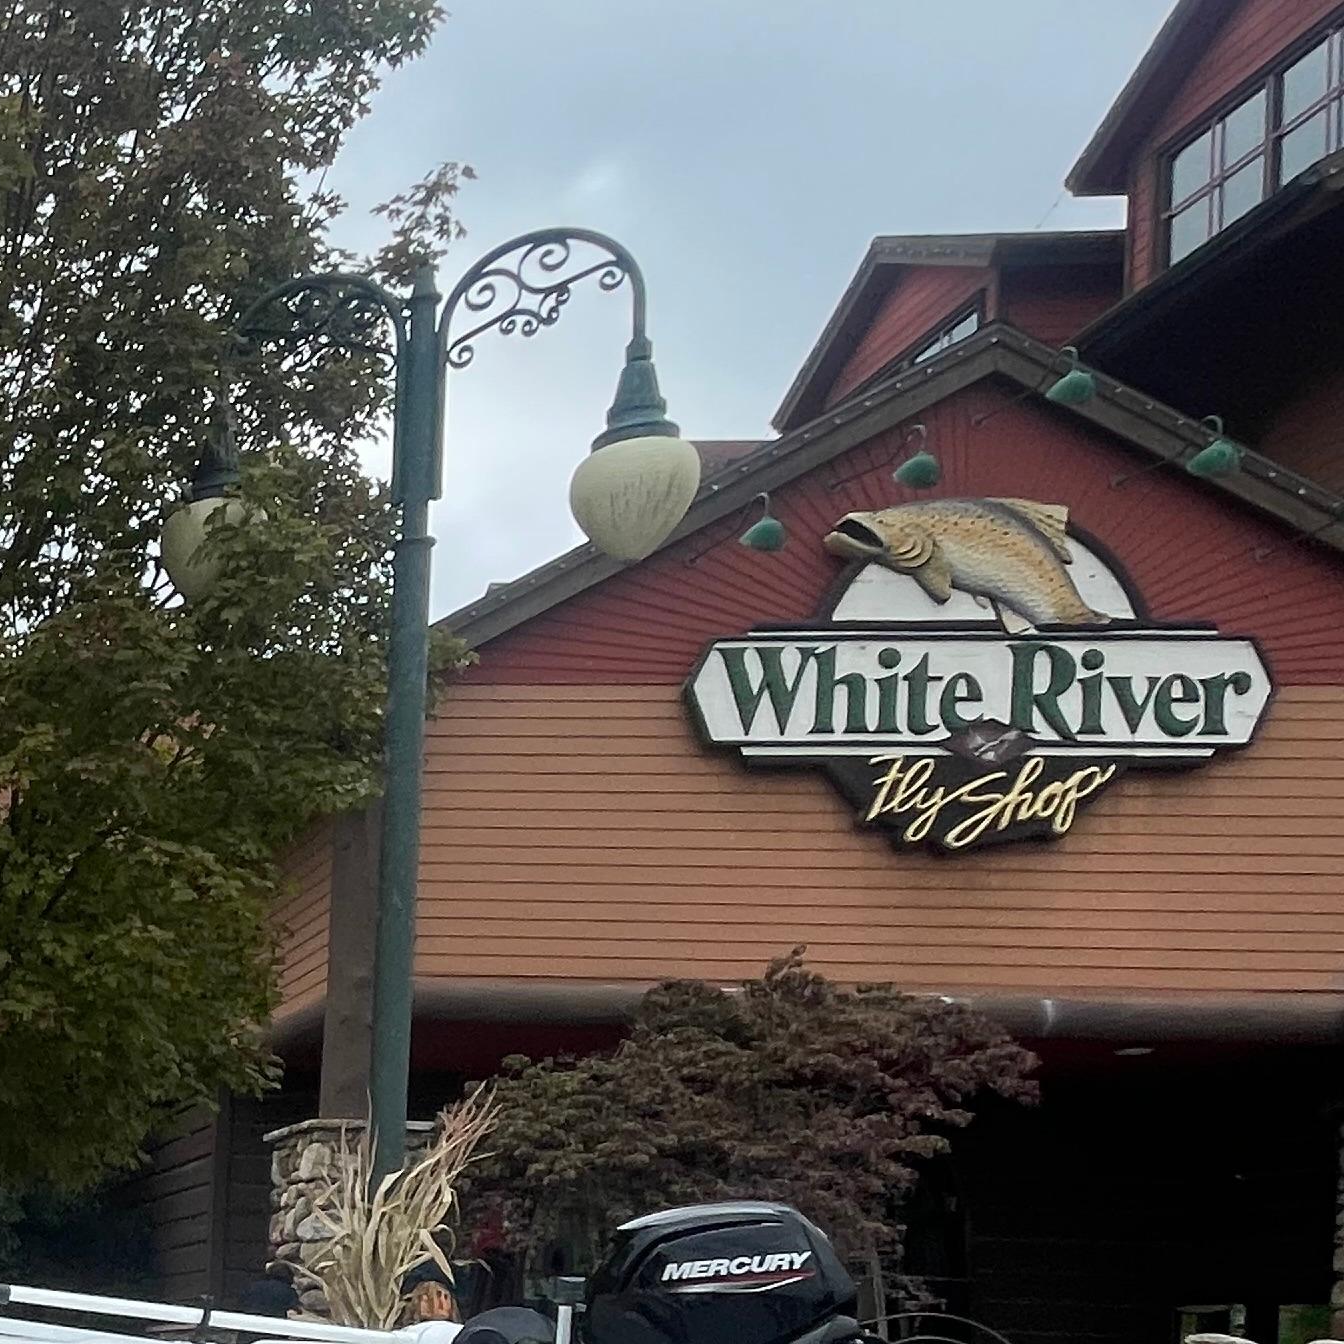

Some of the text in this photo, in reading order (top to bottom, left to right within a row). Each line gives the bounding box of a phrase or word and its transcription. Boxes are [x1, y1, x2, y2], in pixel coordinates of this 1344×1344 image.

[714, 640, 1252, 742] White River
[865, 754, 1116, 849] Fly Shop
[661, 1250, 812, 1282] MERCURY
